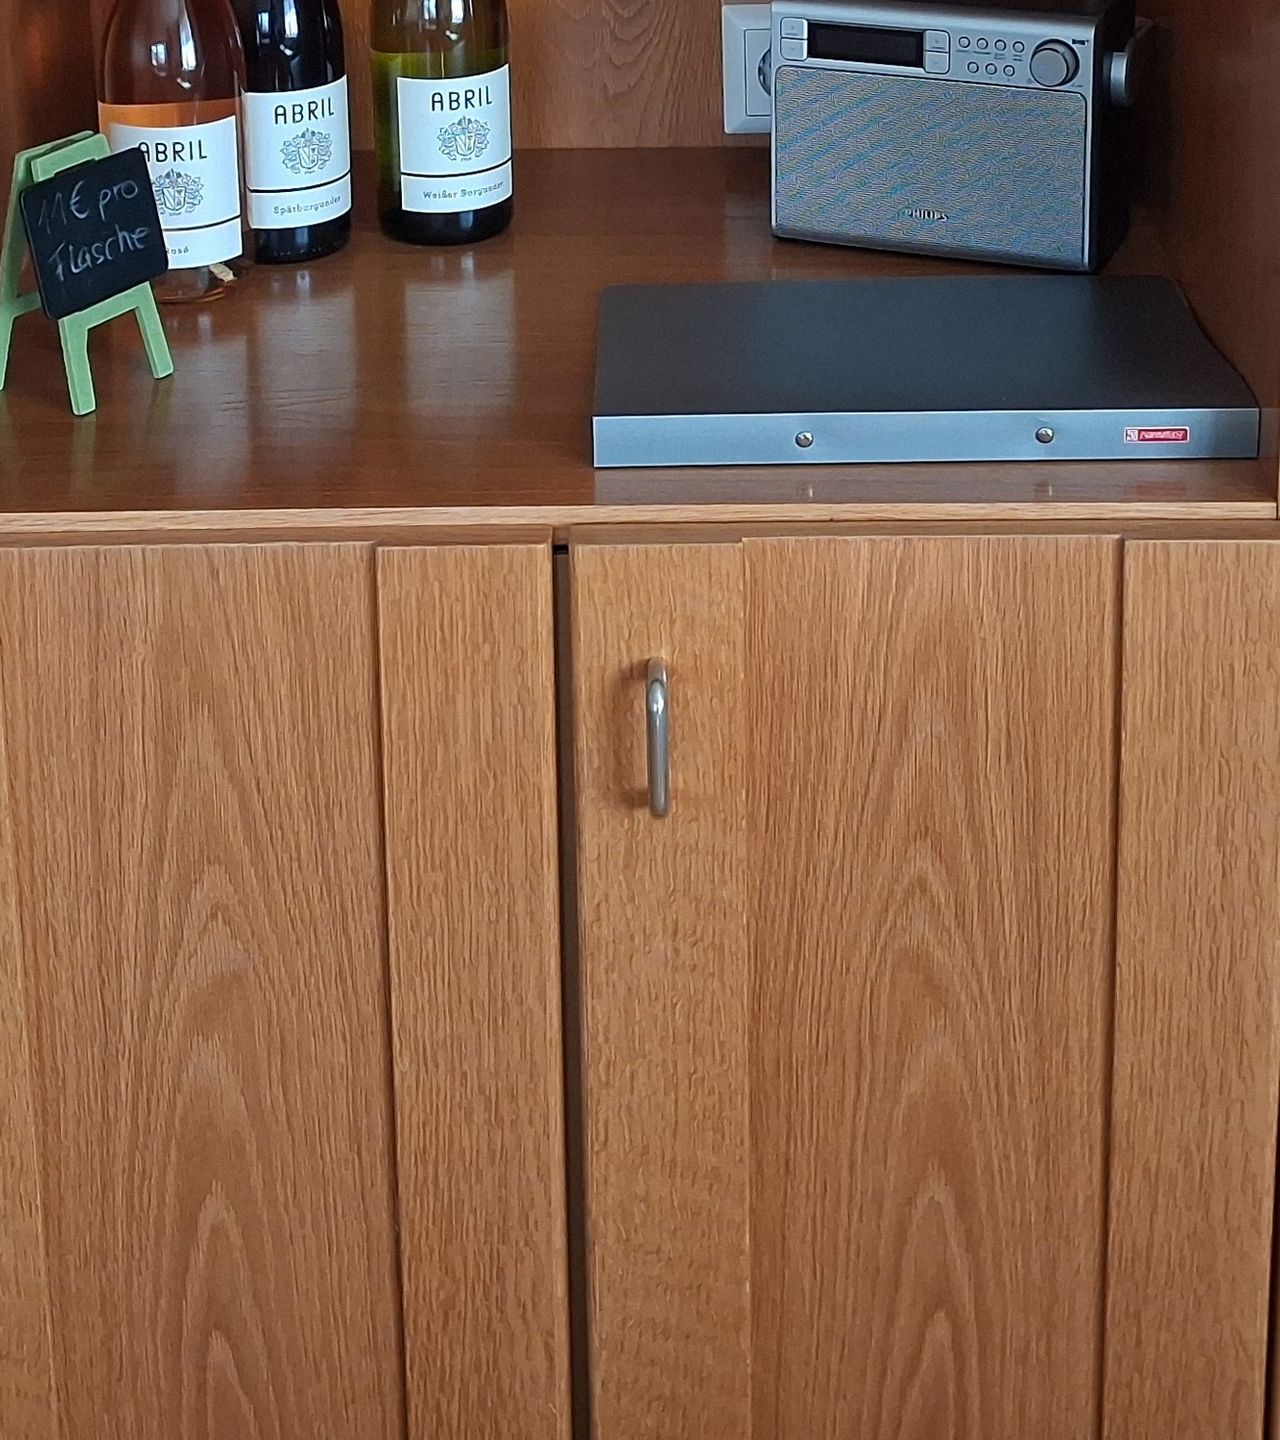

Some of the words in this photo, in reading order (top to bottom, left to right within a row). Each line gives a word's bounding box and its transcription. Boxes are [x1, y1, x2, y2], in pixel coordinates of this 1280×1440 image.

[273, 96, 335, 125] ABRIL
[430, 85, 494, 112] ABRIL
[137, 139, 208, 163] ABRIL
[98, 179, 139, 221] pro
[47, 223, 150, 282] Flasche
